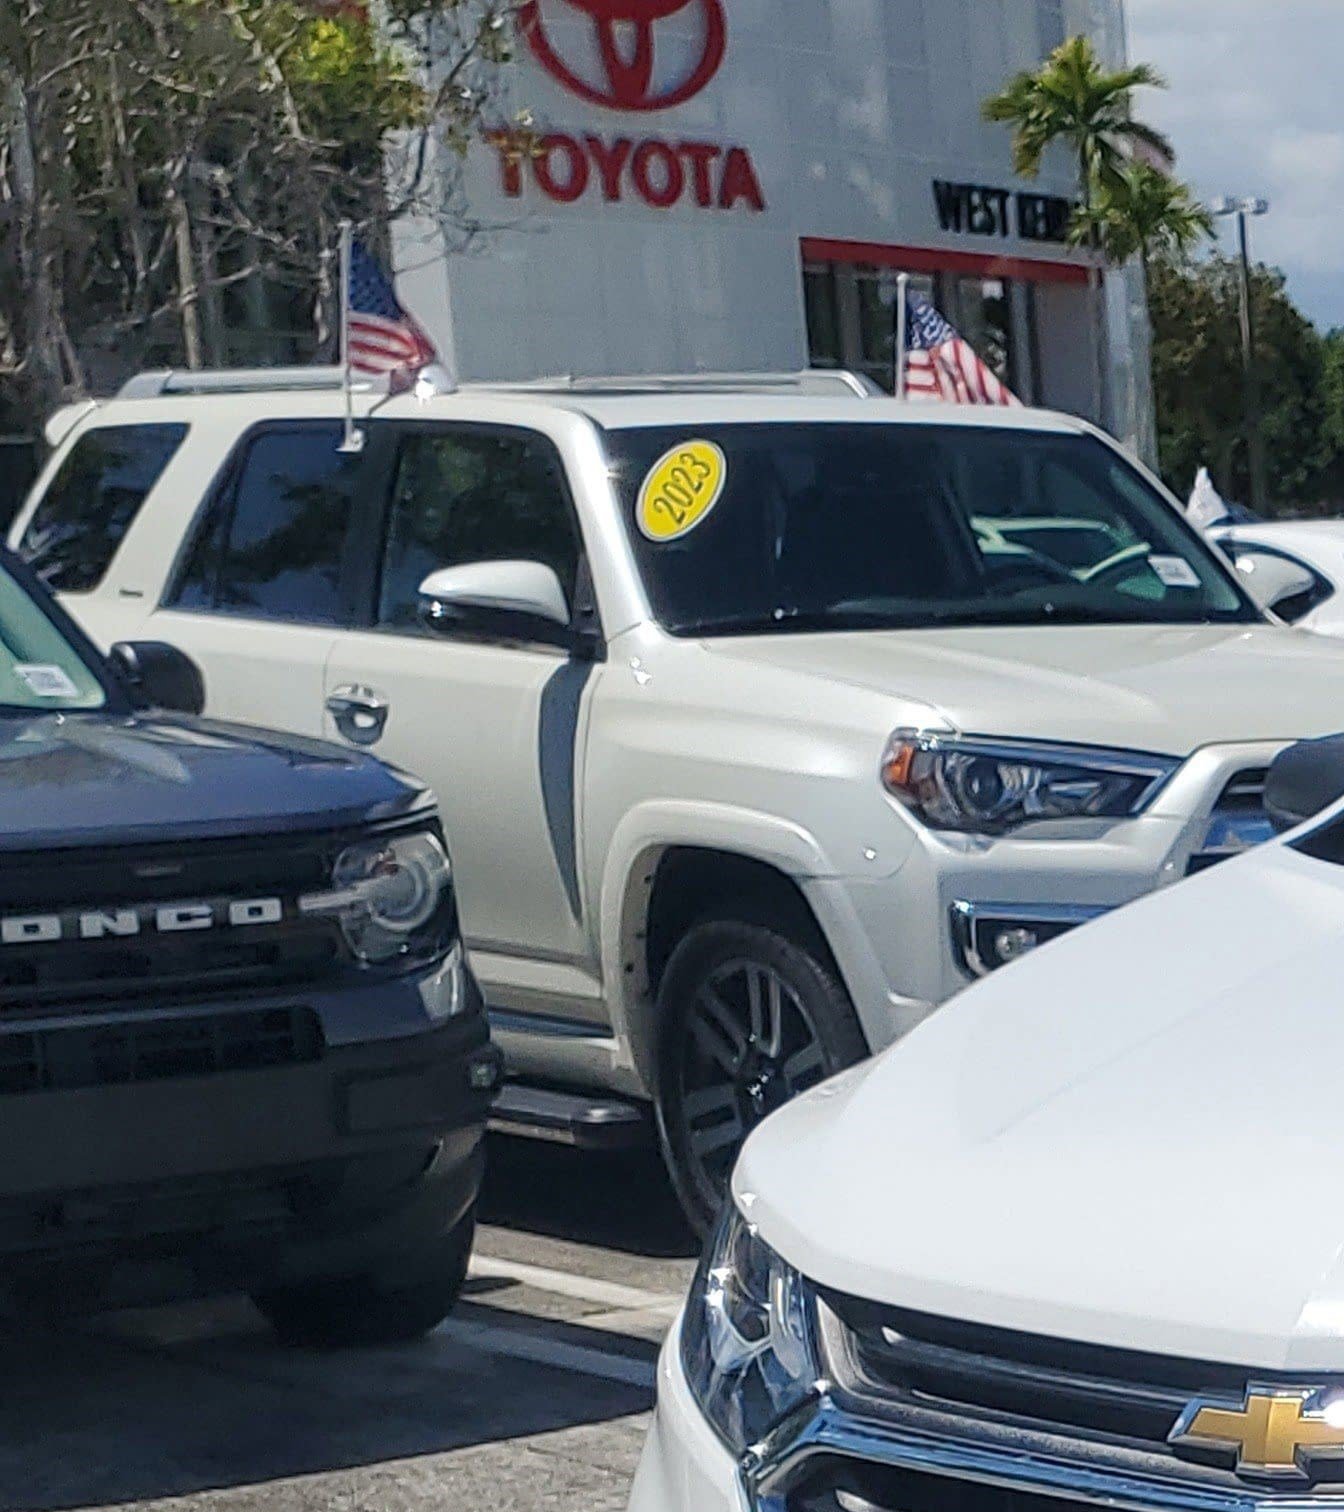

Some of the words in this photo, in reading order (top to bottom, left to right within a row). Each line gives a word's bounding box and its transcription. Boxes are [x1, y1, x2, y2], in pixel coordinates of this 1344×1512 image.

[479, 123, 766, 212] TOYOTA
[932, 179, 1009, 238] WEST
[653, 453, 711, 525] 2023
